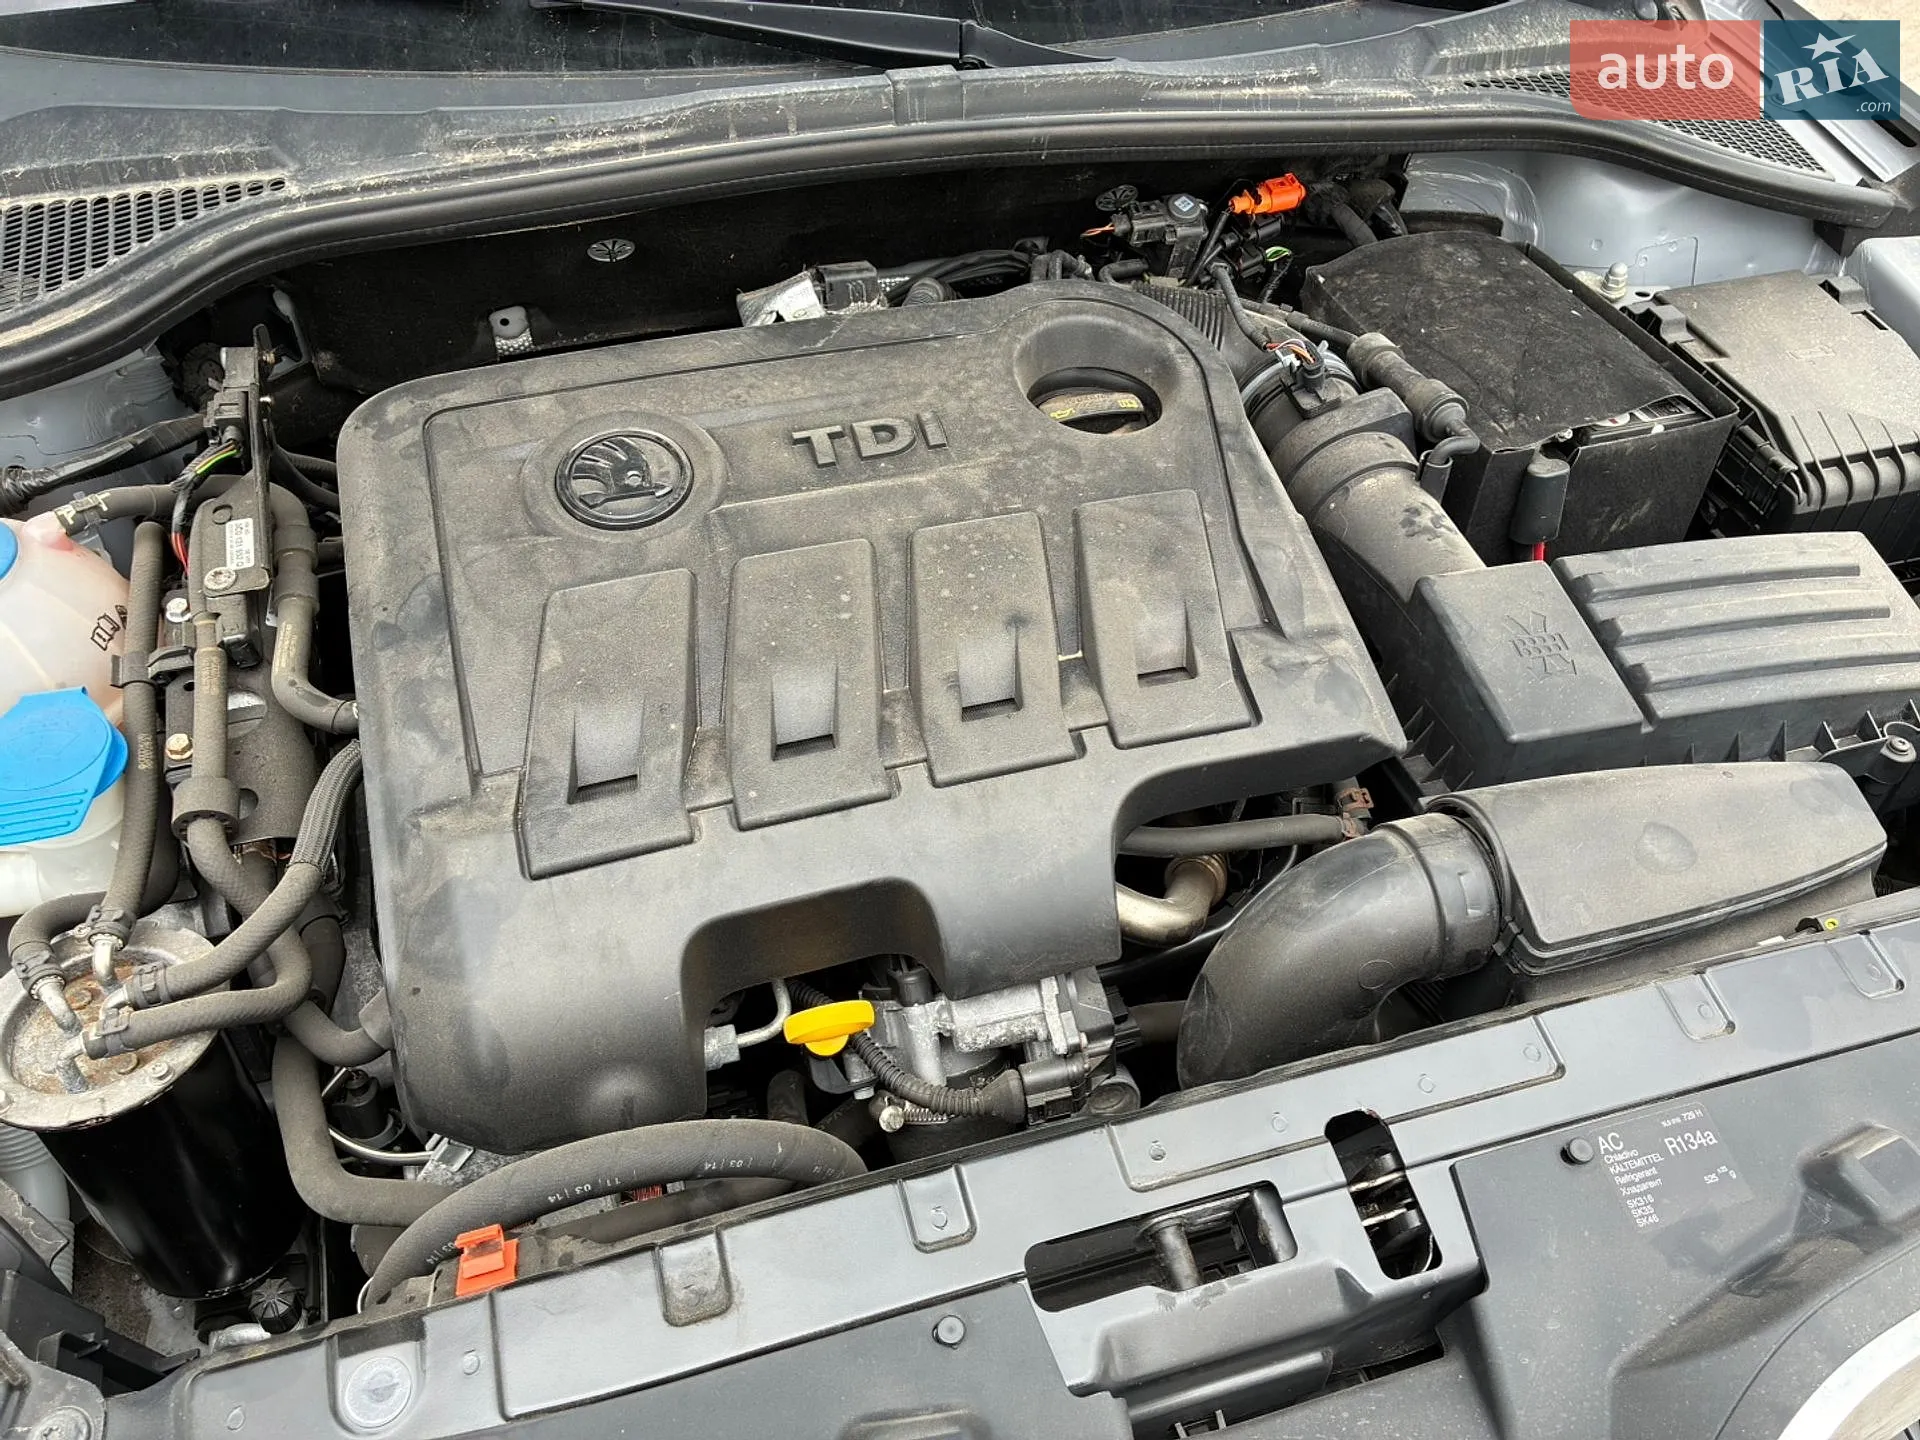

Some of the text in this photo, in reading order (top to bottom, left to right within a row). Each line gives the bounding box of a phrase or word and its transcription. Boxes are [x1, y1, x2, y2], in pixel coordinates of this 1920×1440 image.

[1598, 1132, 1624, 1154] AC
[1663, 1130, 1718, 1156] R134a
[1615, 1166, 1658, 1185] Refrigerant
